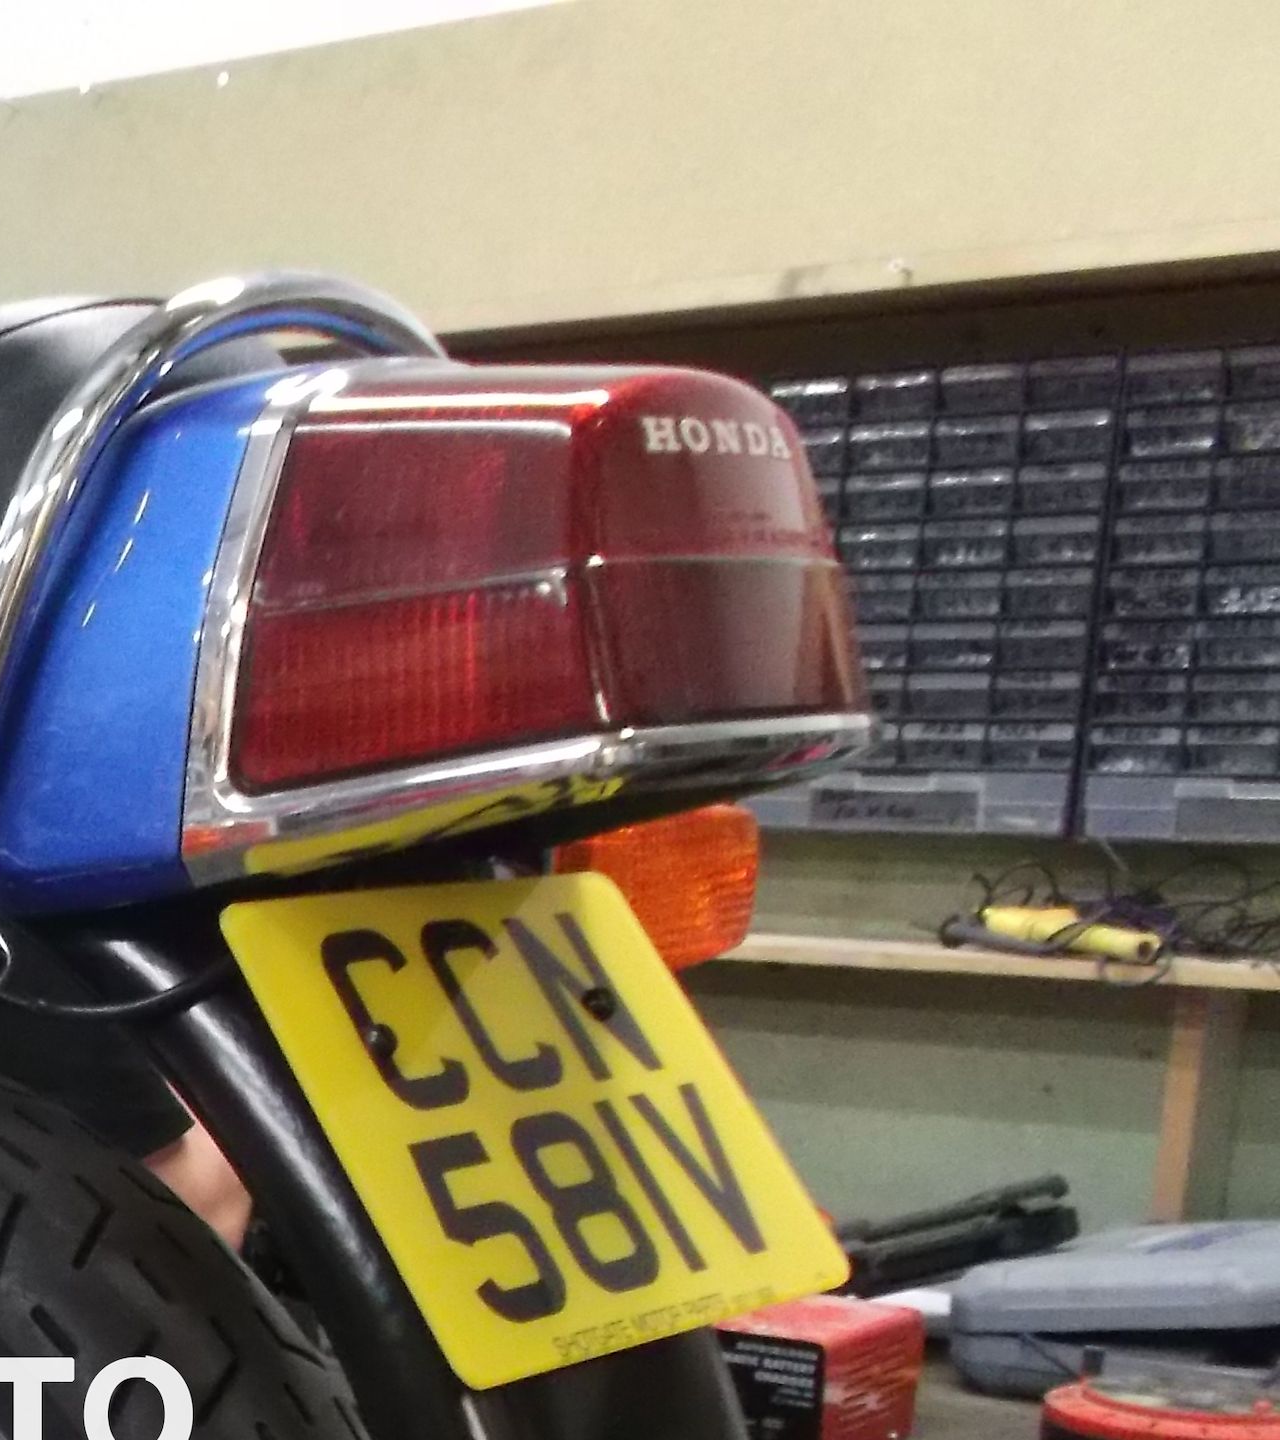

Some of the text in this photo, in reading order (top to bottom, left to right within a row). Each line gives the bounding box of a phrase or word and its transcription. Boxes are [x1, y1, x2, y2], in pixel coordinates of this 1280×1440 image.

[641, 415, 791, 459] HONDA
[319, 911, 664, 1111] CCN
[407, 1081, 769, 1324] 581V
